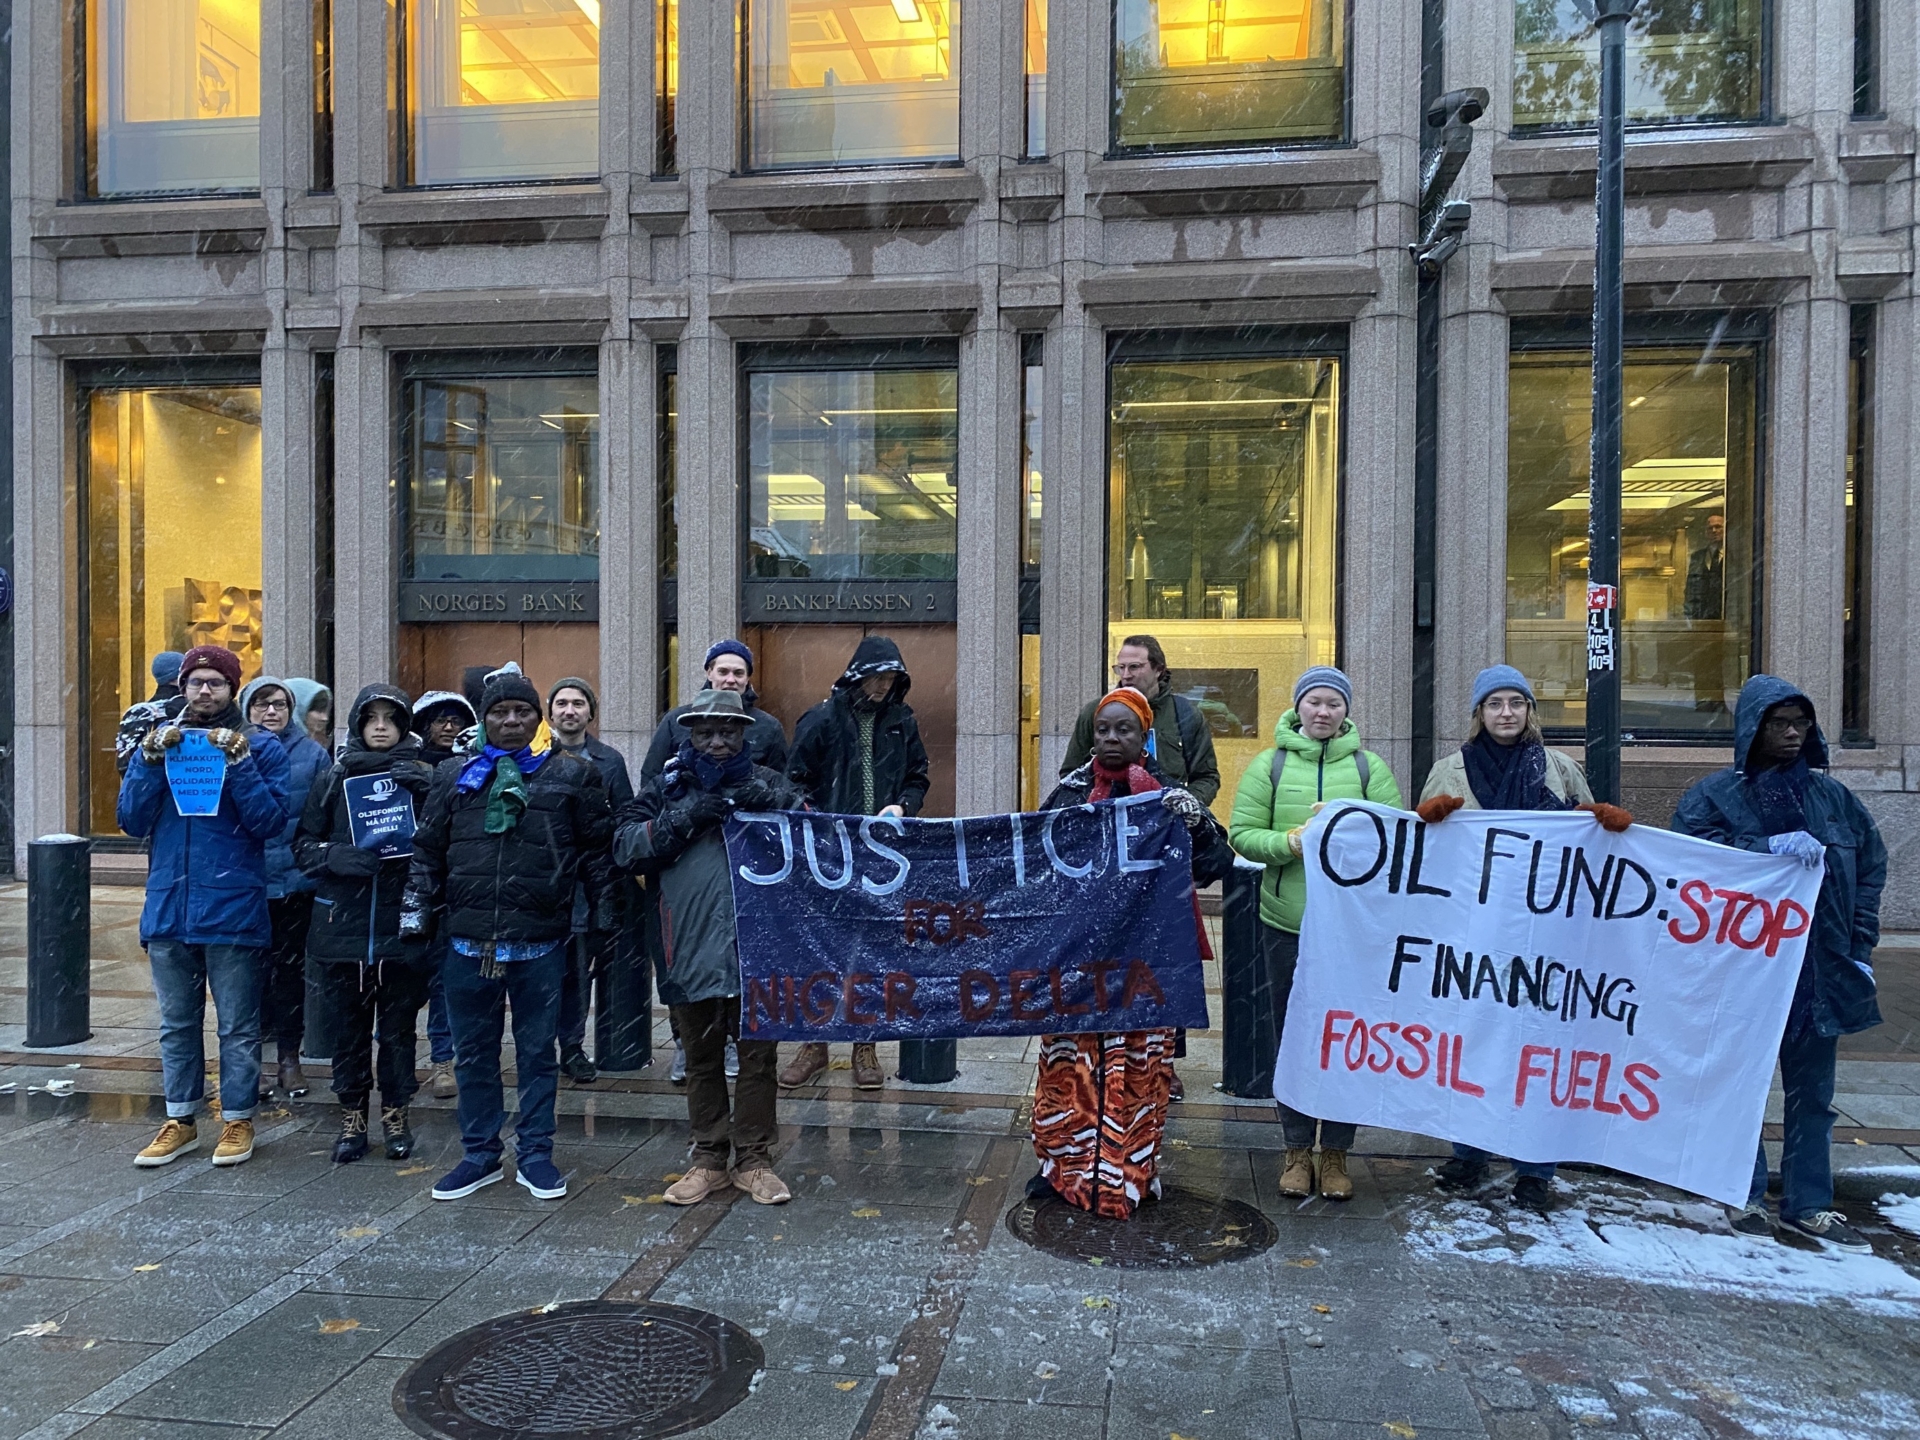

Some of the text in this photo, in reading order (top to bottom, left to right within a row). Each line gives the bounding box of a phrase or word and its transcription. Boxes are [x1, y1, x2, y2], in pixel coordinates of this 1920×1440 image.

[418, 593, 585, 612] NORGES BANK
[765, 593, 936, 611] BANKPLASSEN 2
[358, 805, 408, 818] OLJEFONDET
[366, 818, 379, 826] MÅ
[380, 817, 390, 825] UT
[733, 790, 1165, 895] JUSTICE
[1318, 806, 1811, 957] OIL FUND: STOP
[904, 899, 992, 947] FOR
[748, 959, 1166, 1032] NIGER DELTA
[1388, 935, 1640, 1037] FINANCING
[1319, 1009, 1662, 1122] FOSSIL FUELS
